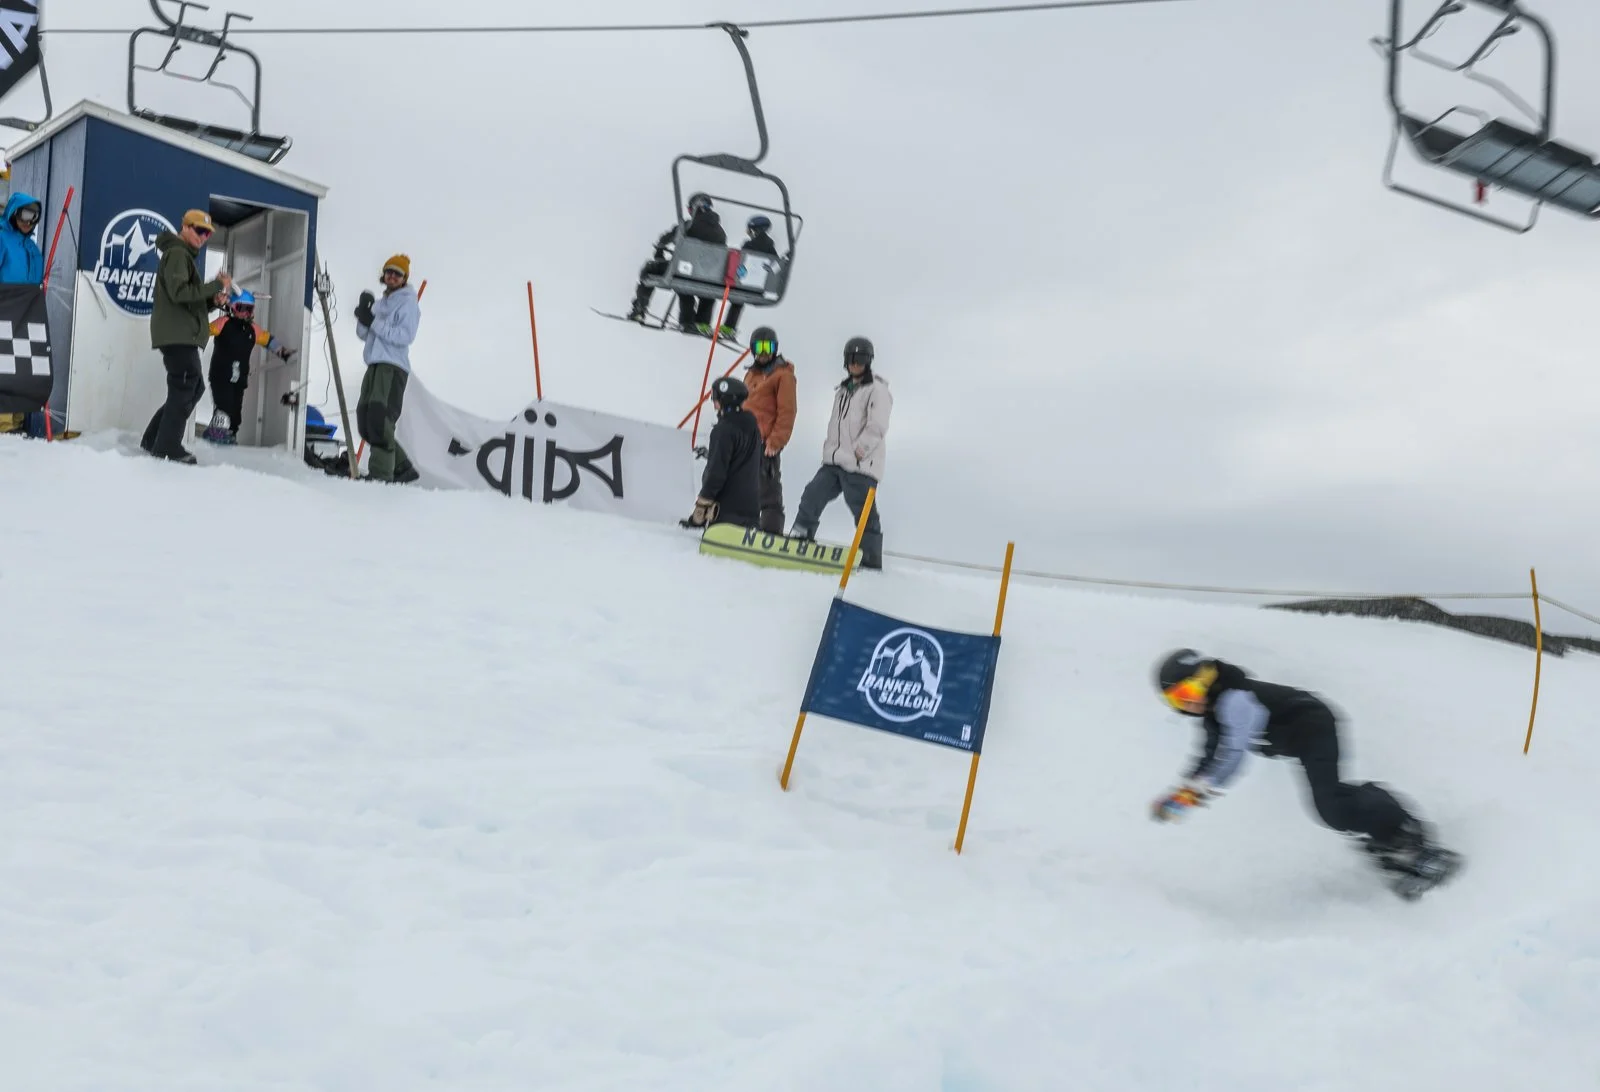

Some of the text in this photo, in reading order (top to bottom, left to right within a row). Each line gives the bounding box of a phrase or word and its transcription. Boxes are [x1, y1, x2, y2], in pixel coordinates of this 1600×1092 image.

[117, 284, 155, 303] SLAL
[741, 526, 844, 562] BURTON
[865, 673, 922, 696] BANKED
[878, 690, 935, 712] SLALOM
